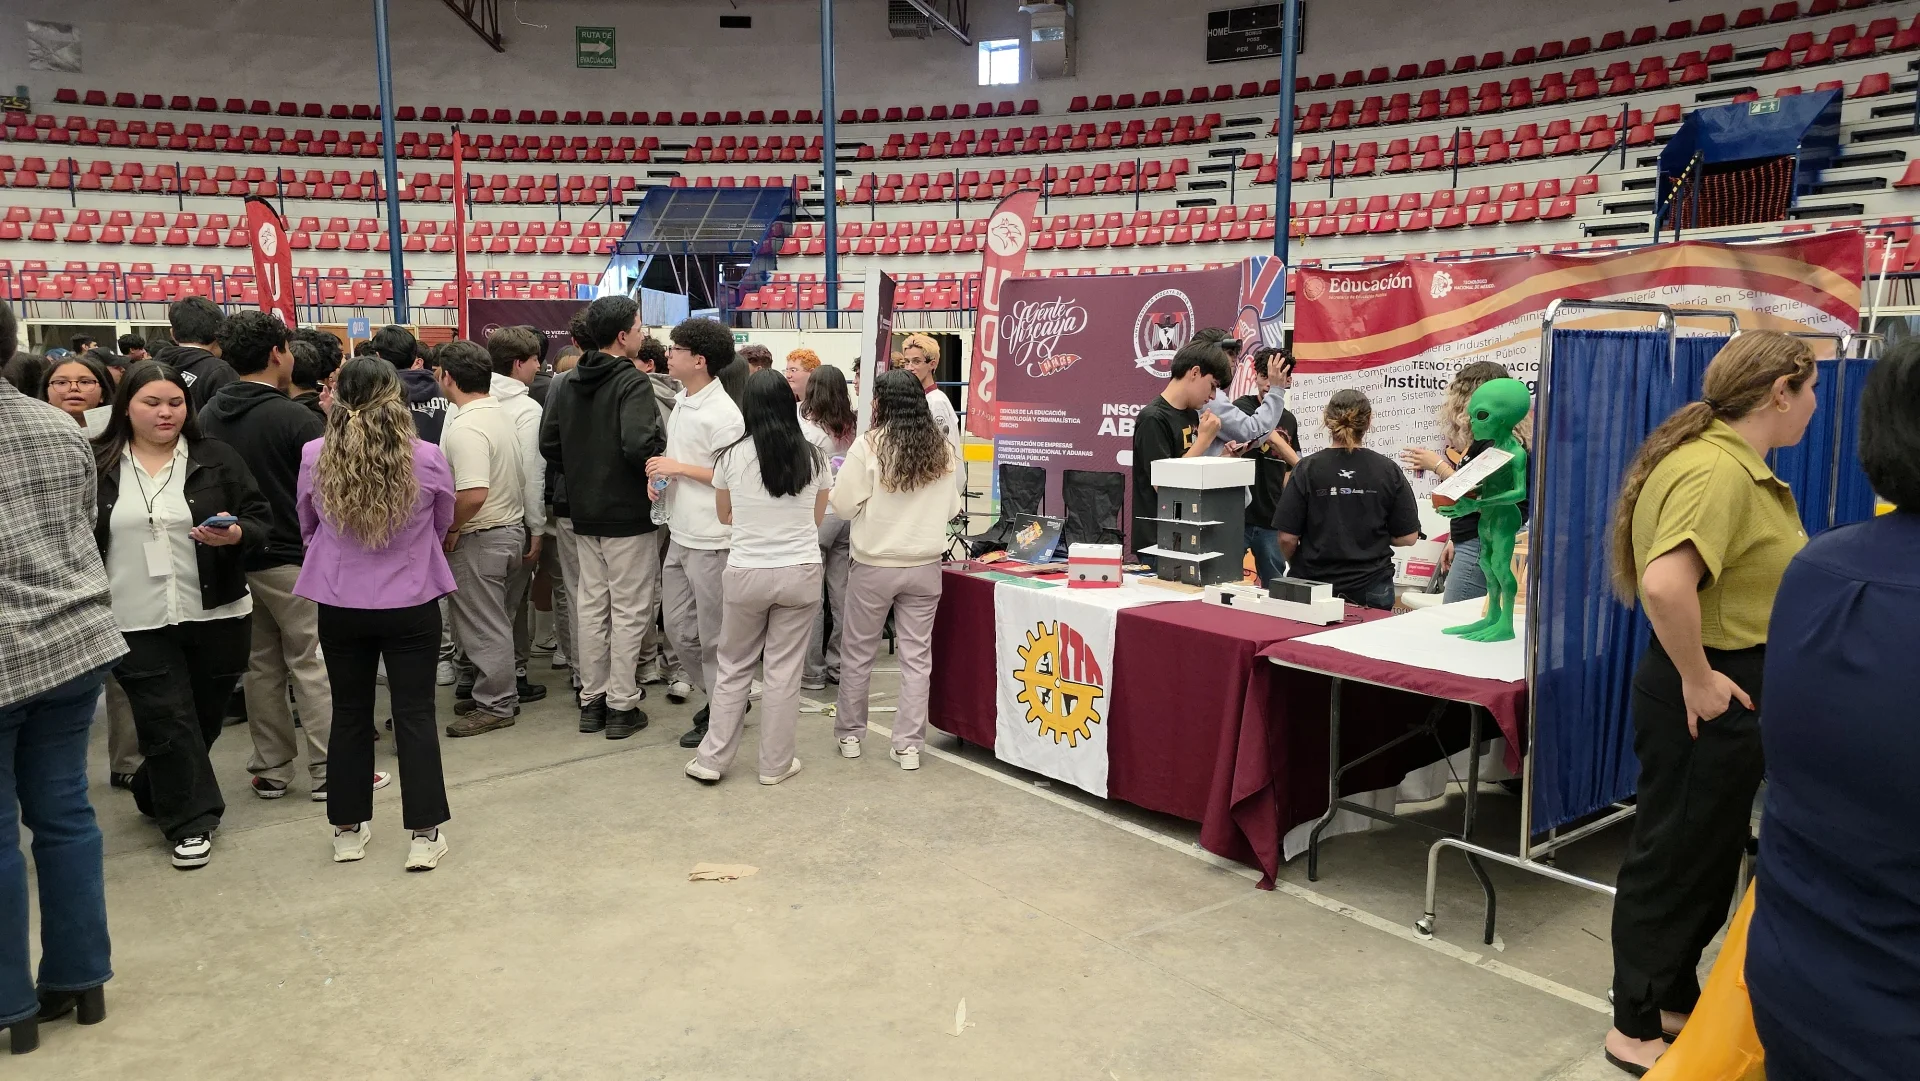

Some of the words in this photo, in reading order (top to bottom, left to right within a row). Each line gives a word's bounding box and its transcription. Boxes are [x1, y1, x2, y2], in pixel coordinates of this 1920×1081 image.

[581, 31, 601, 39] RUTA
[1207, 27, 1229, 37] HOME
[1329, 272, 1412, 293] Educación
[1715, 294, 1731, 304] en
[1318, 373, 1352, 385] Sistemas
[1384, 373, 1449, 390] Instituto
[1371, 406, 1416, 419] lectrónica
[1097, 417, 1136, 437] AB
[1304, 418, 1319, 426] Civil
[1378, 437, 1394, 446] Civil
